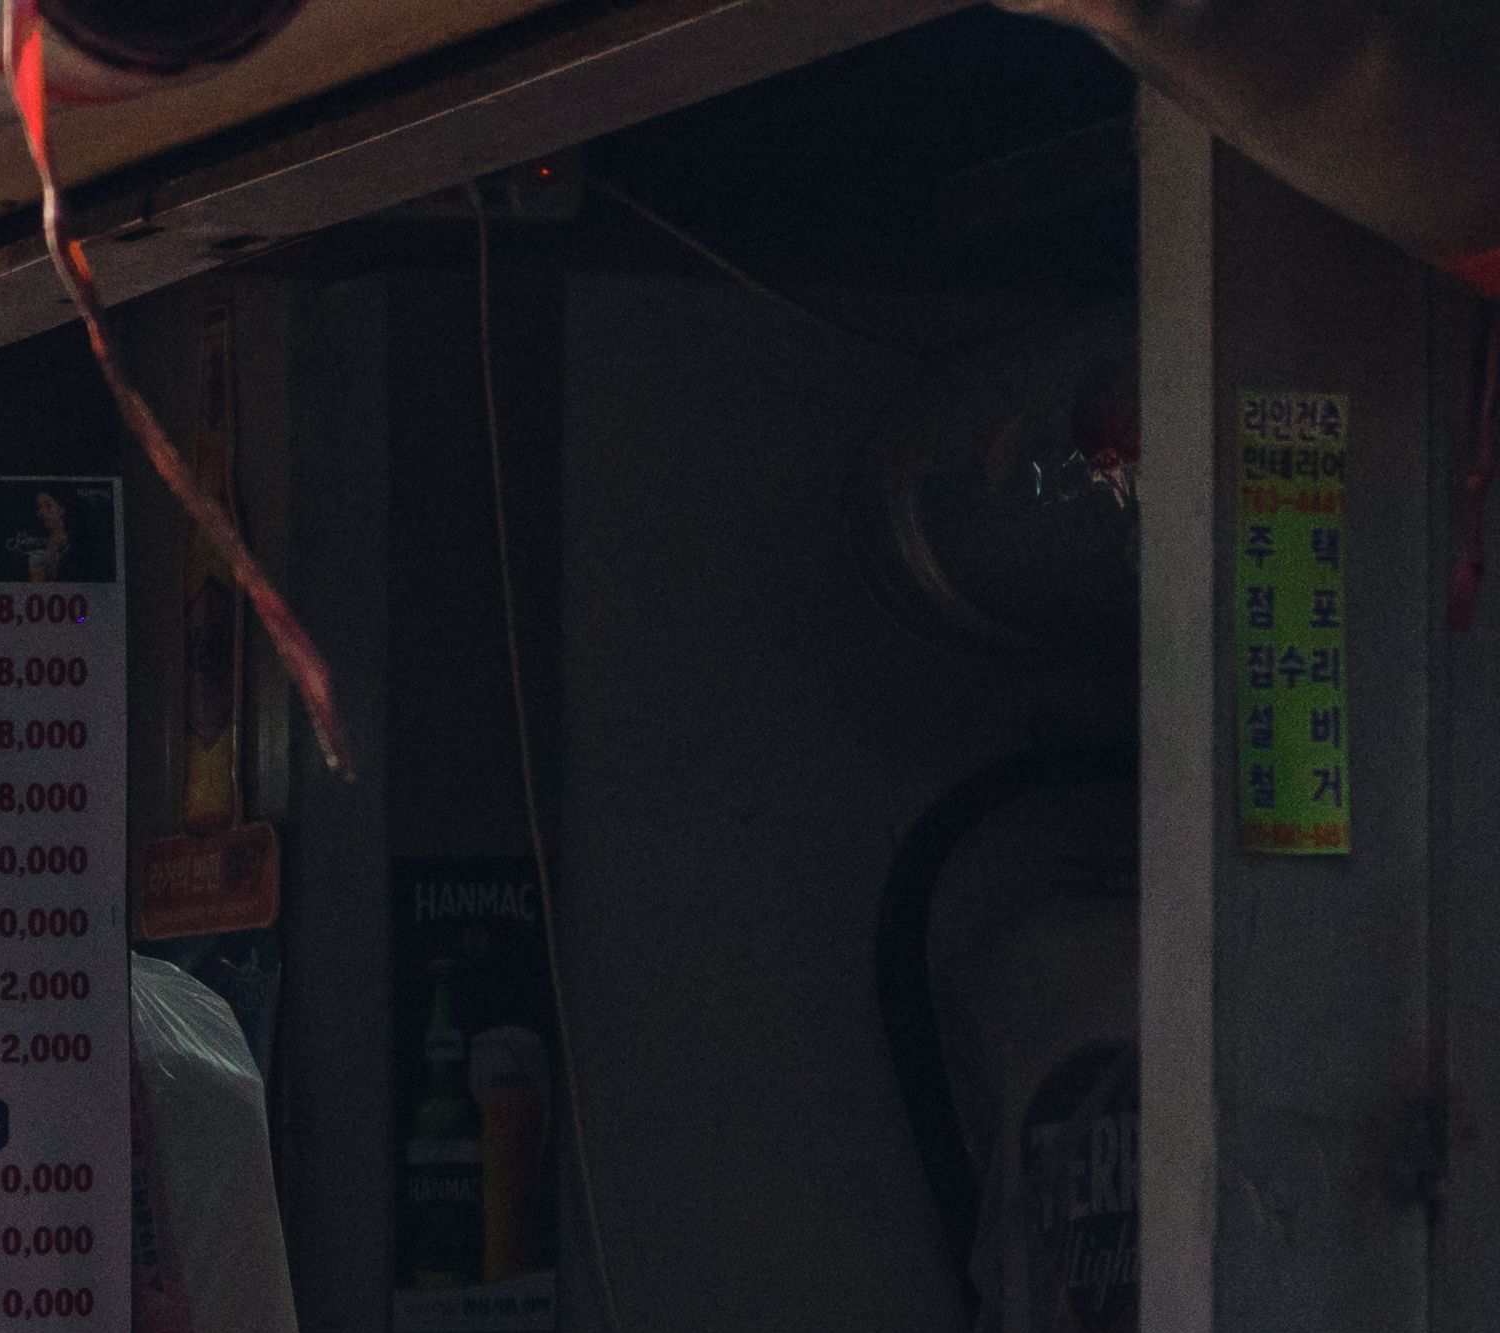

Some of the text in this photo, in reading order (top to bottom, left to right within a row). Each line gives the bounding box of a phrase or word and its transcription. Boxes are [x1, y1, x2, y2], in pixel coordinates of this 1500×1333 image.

[1247, 587, 1341, 632] 점포
[1247, 646, 1341, 692] 집수리
[414, 882, 537, 921] HANMAC
